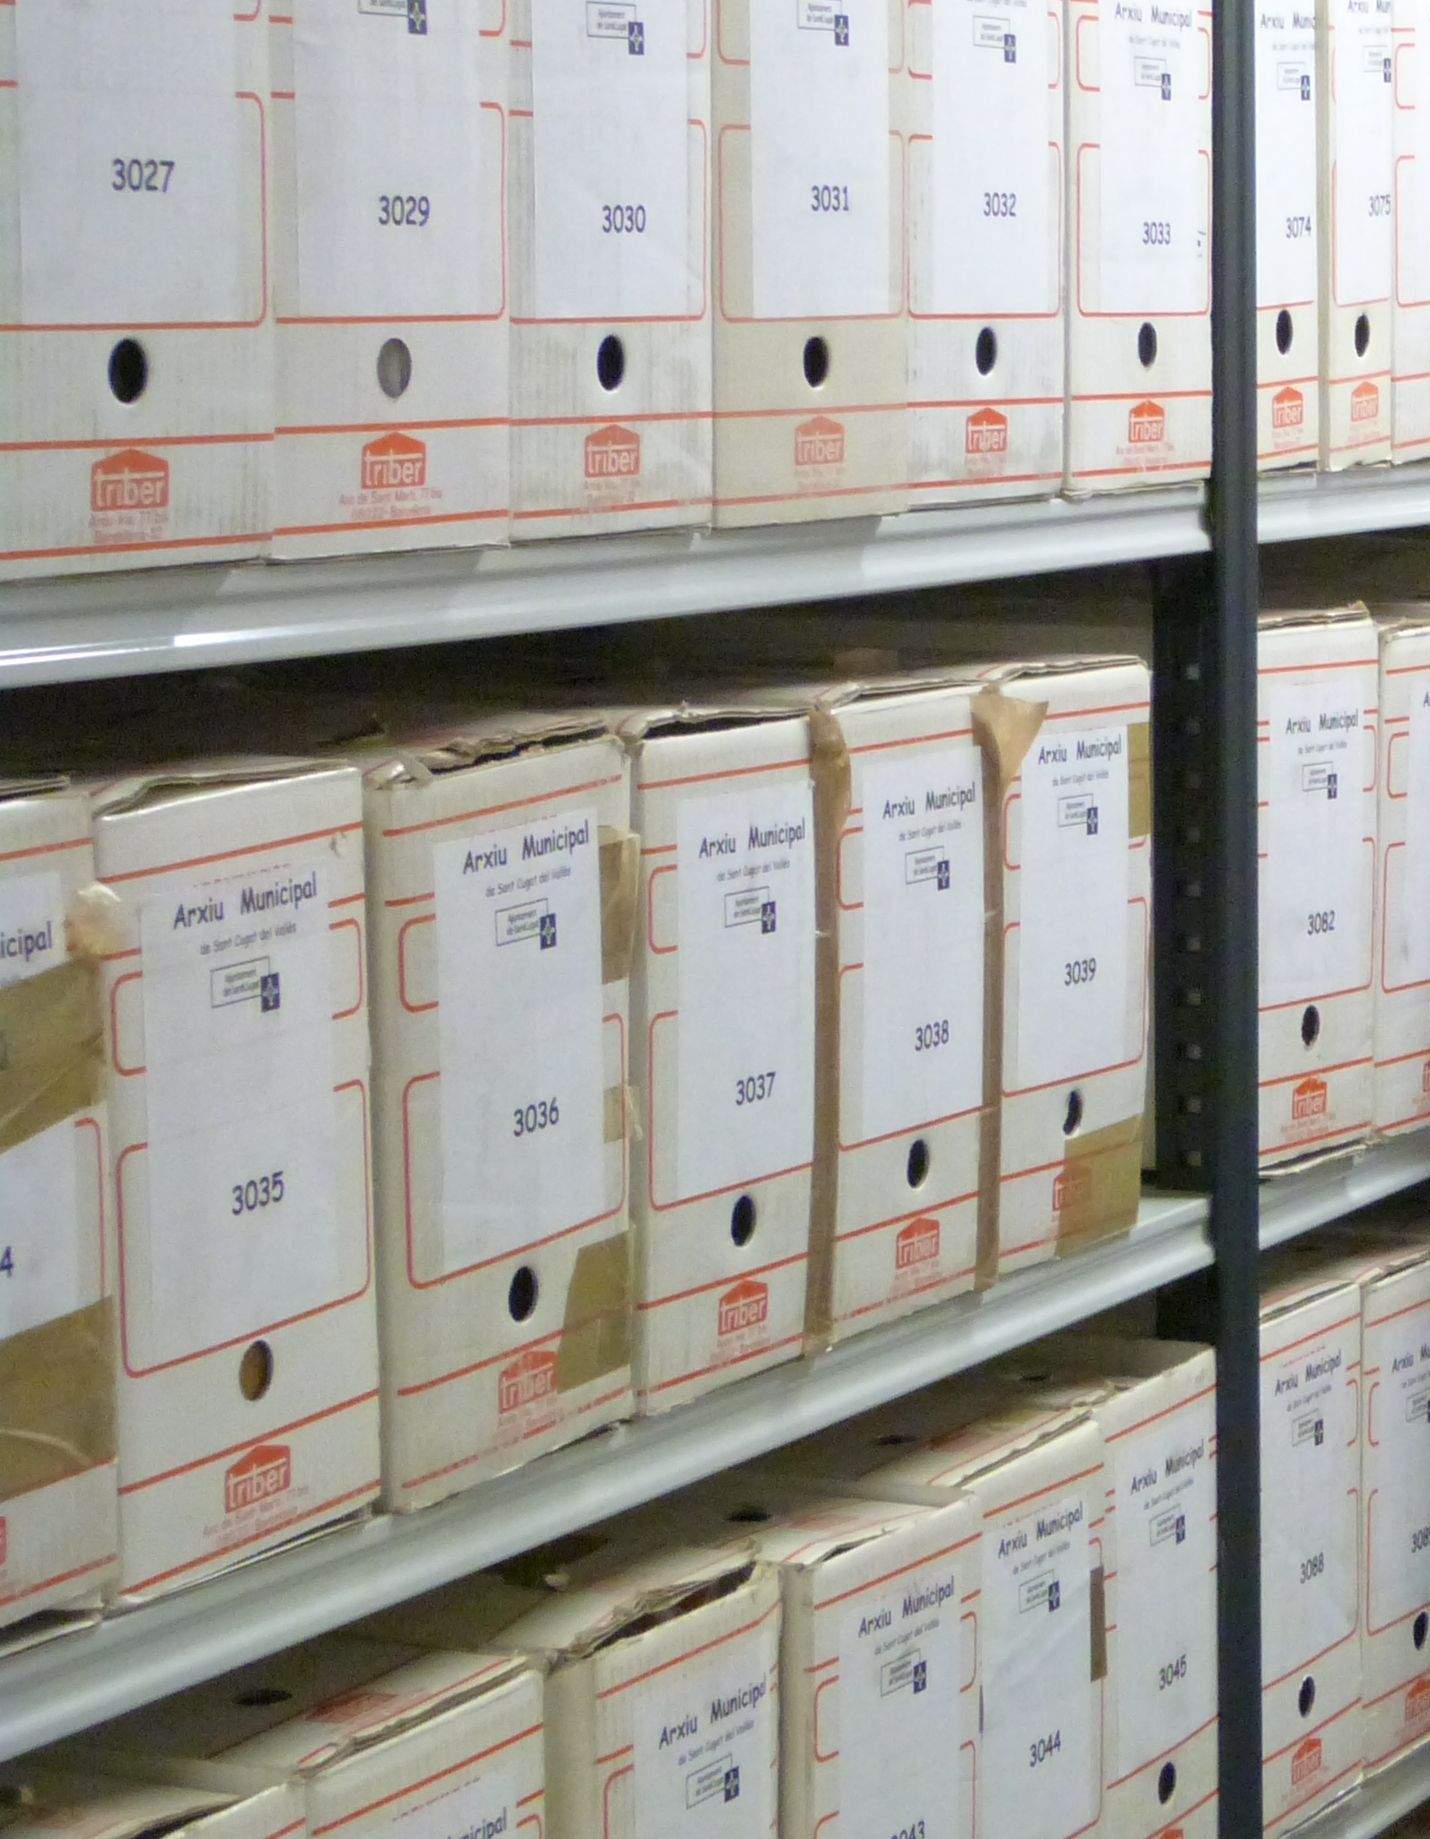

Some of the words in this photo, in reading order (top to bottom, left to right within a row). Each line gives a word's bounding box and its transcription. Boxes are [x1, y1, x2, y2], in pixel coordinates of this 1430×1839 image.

[1115, 2, 1142, 22] Arxiu
[1151, 4, 1192, 31] Municipal
[112, 159, 174, 192] 3027
[378, 196, 430, 227] 3029
[811, 185, 850, 213] 3031
[983, 192, 1017, 218] 3032
[1369, 195, 1391, 217] 3075
[601, 205, 646, 233] 3030
[1142, 222, 1171, 246] 3033
[1286, 216, 1311, 238] 3074
[364, 448, 423, 486] triber
[587, 443, 638, 474] triber
[94, 467, 164, 508] triber
[1285, 716, 1311, 735] Arxiu
[1038, 743, 1067, 765] Arxiu
[1076, 733, 1121, 761] Municipal
[882, 795, 915, 819] Arxiu
[925, 781, 976, 812] Municipal
[463, 843, 507, 875] Arxiu
[522, 819, 589, 860] Municipal
[699, 832, 736, 859] Arxiu
[748, 817, 805, 850] Municipal
[173, 897, 225, 930] Arxiu
[240, 870, 317, 915] Municipal
[1064, 957, 1096, 986] 3039
[915, 1019, 950, 1051] 3038
[735, 1072, 776, 1106] 3037
[513, 1096, 560, 1137] 3036
[232, 1170, 285, 1216] 3035
[720, 1291, 766, 1333] triber
[1274, 1374, 1298, 1396] Arxiu
[1305, 1350, 1342, 1382] Municipal
[229, 1457, 287, 1509] triber
[1130, 1467, 1157, 1495] Arxiu
[998, 1530, 1028, 1559] Arxiu
[1036, 1500, 1083, 1540] Municipal
[858, 1609, 892, 1638] Arxiu
[902, 1575, 954, 1618] Municipal
[1158, 1654, 1187, 1691] 3045
[659, 1715, 698, 1750] Arxiu
[1029, 1729, 1061, 1768] 3044
